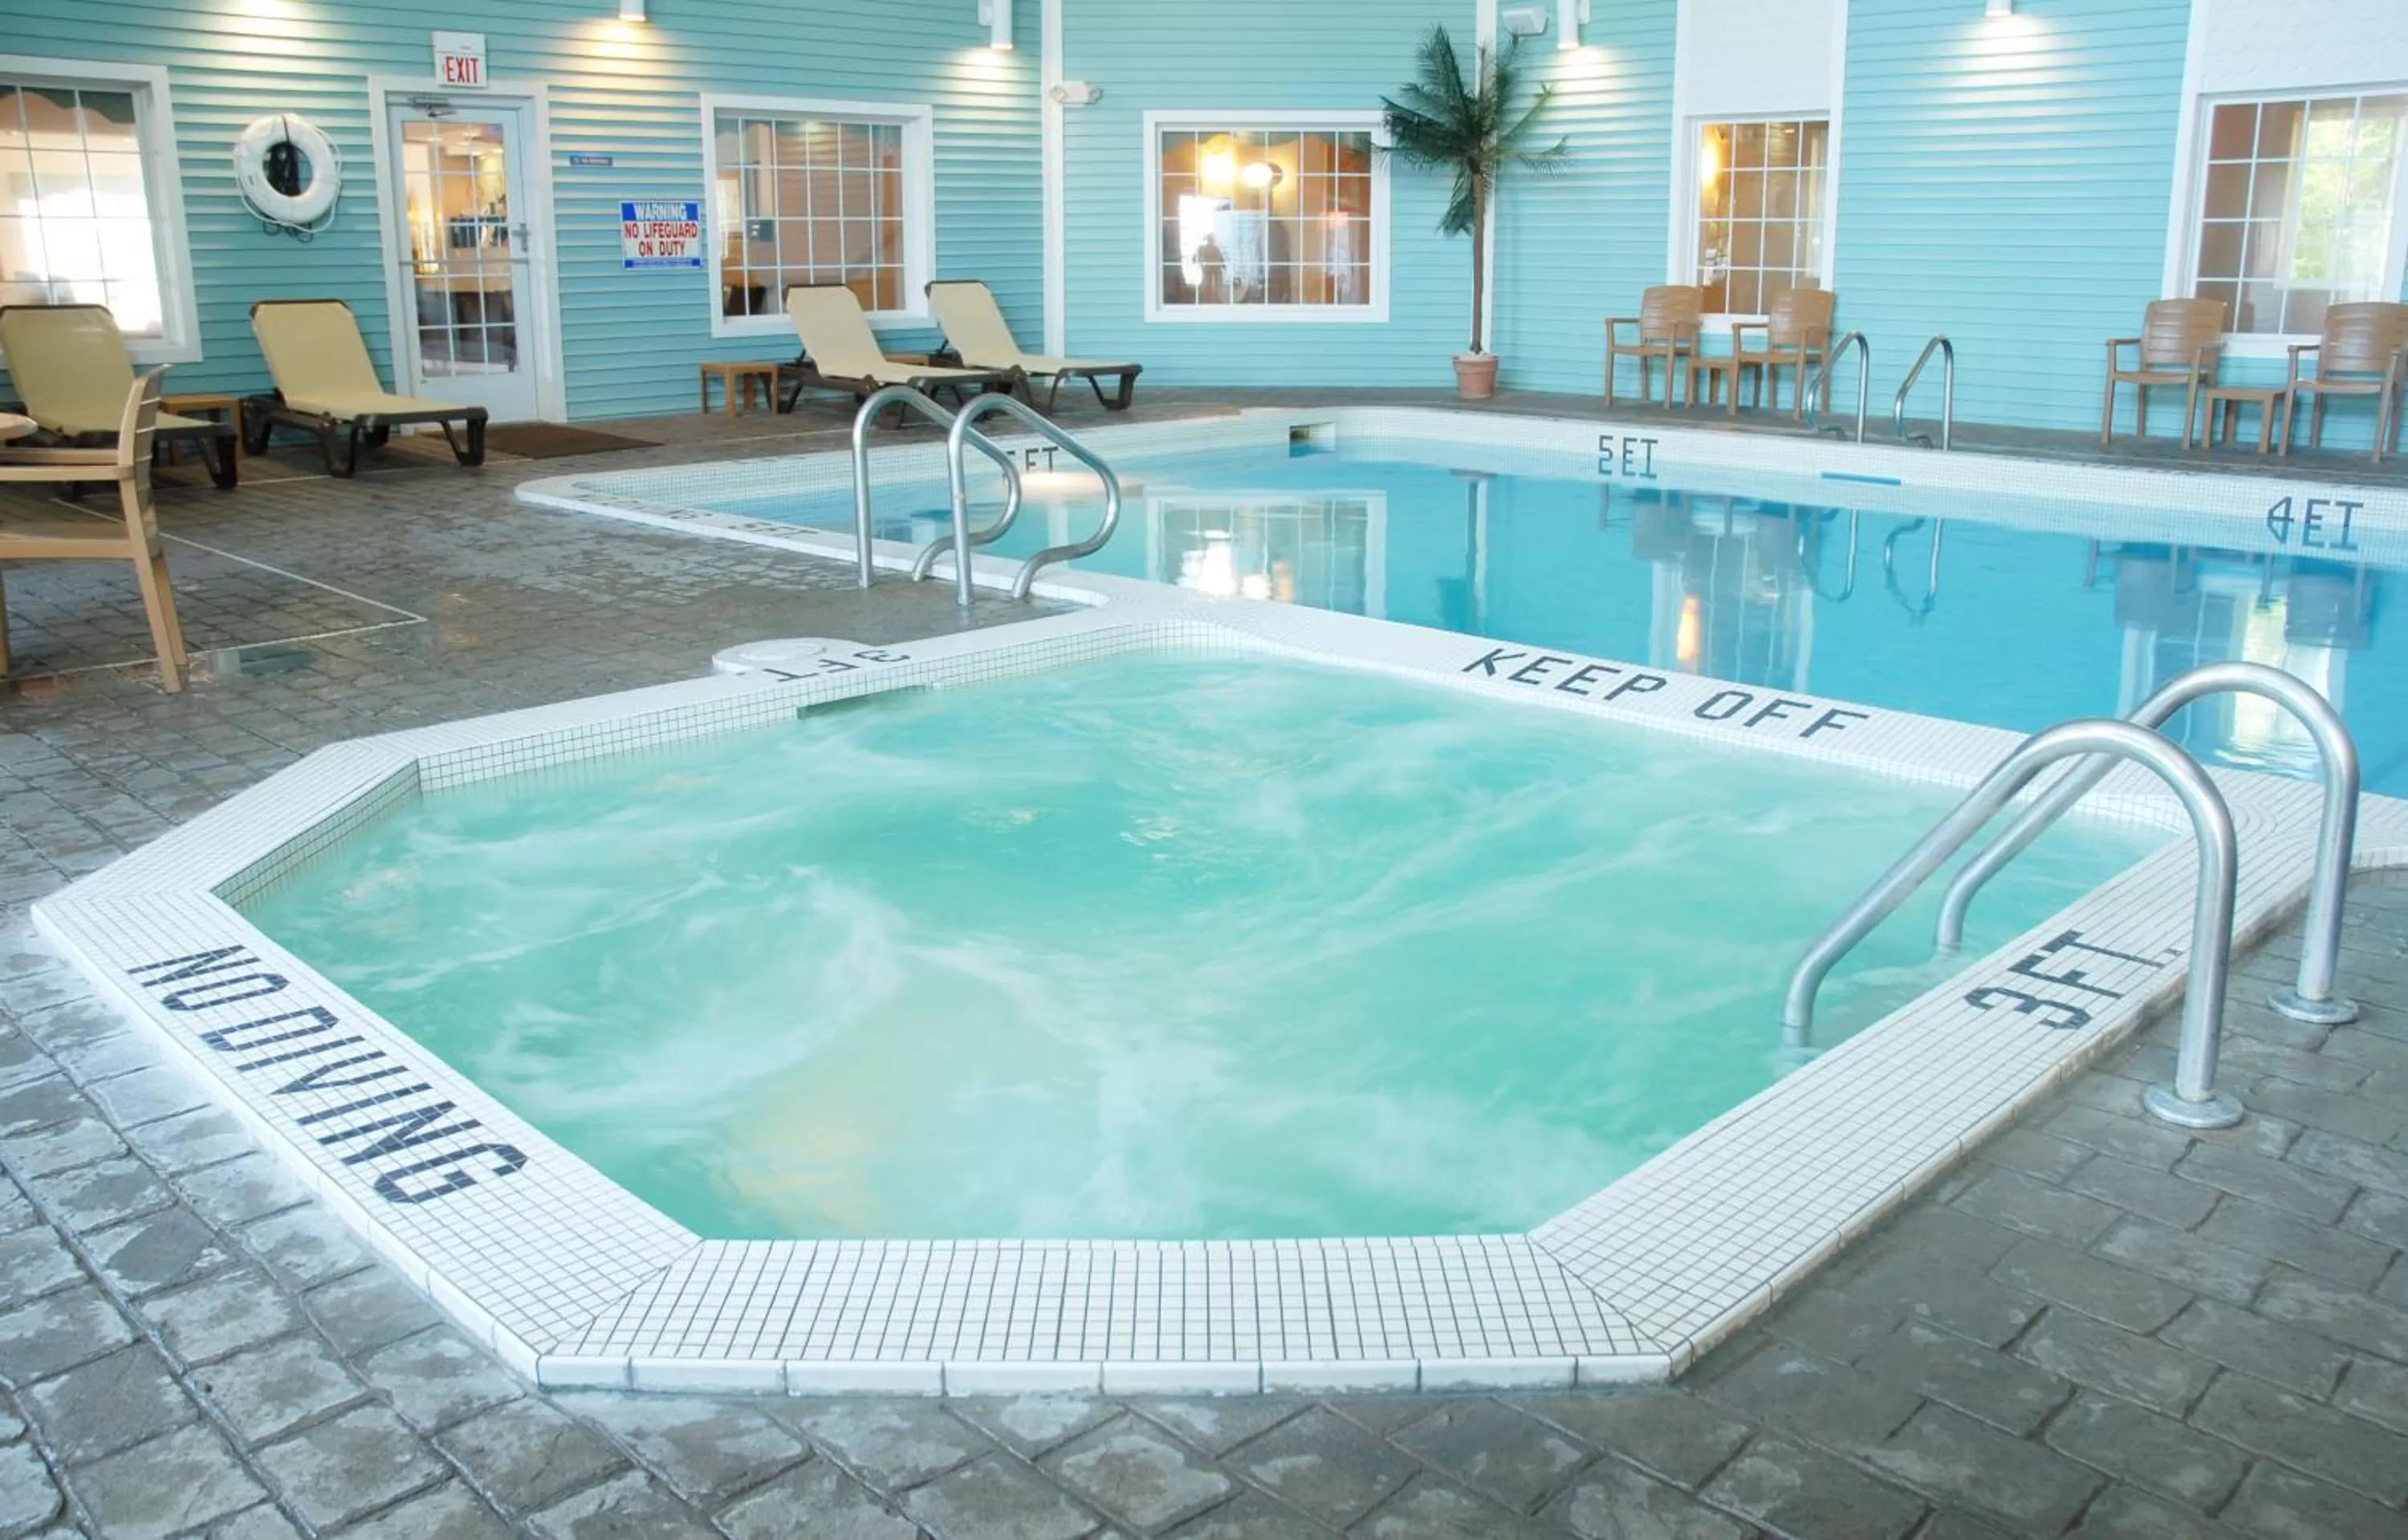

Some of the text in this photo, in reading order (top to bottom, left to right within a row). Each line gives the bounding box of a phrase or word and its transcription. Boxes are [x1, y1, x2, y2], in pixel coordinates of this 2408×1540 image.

[445, 56, 479, 84] EXIT
[634, 202, 687, 222] WARNING
[624, 223, 698, 238] NO LIFEGUARD
[639, 241, 684, 256] ON DUTY
[1461, 647, 1869, 739] KEEP OFF
[126, 943, 528, 1204] NO DIVING
